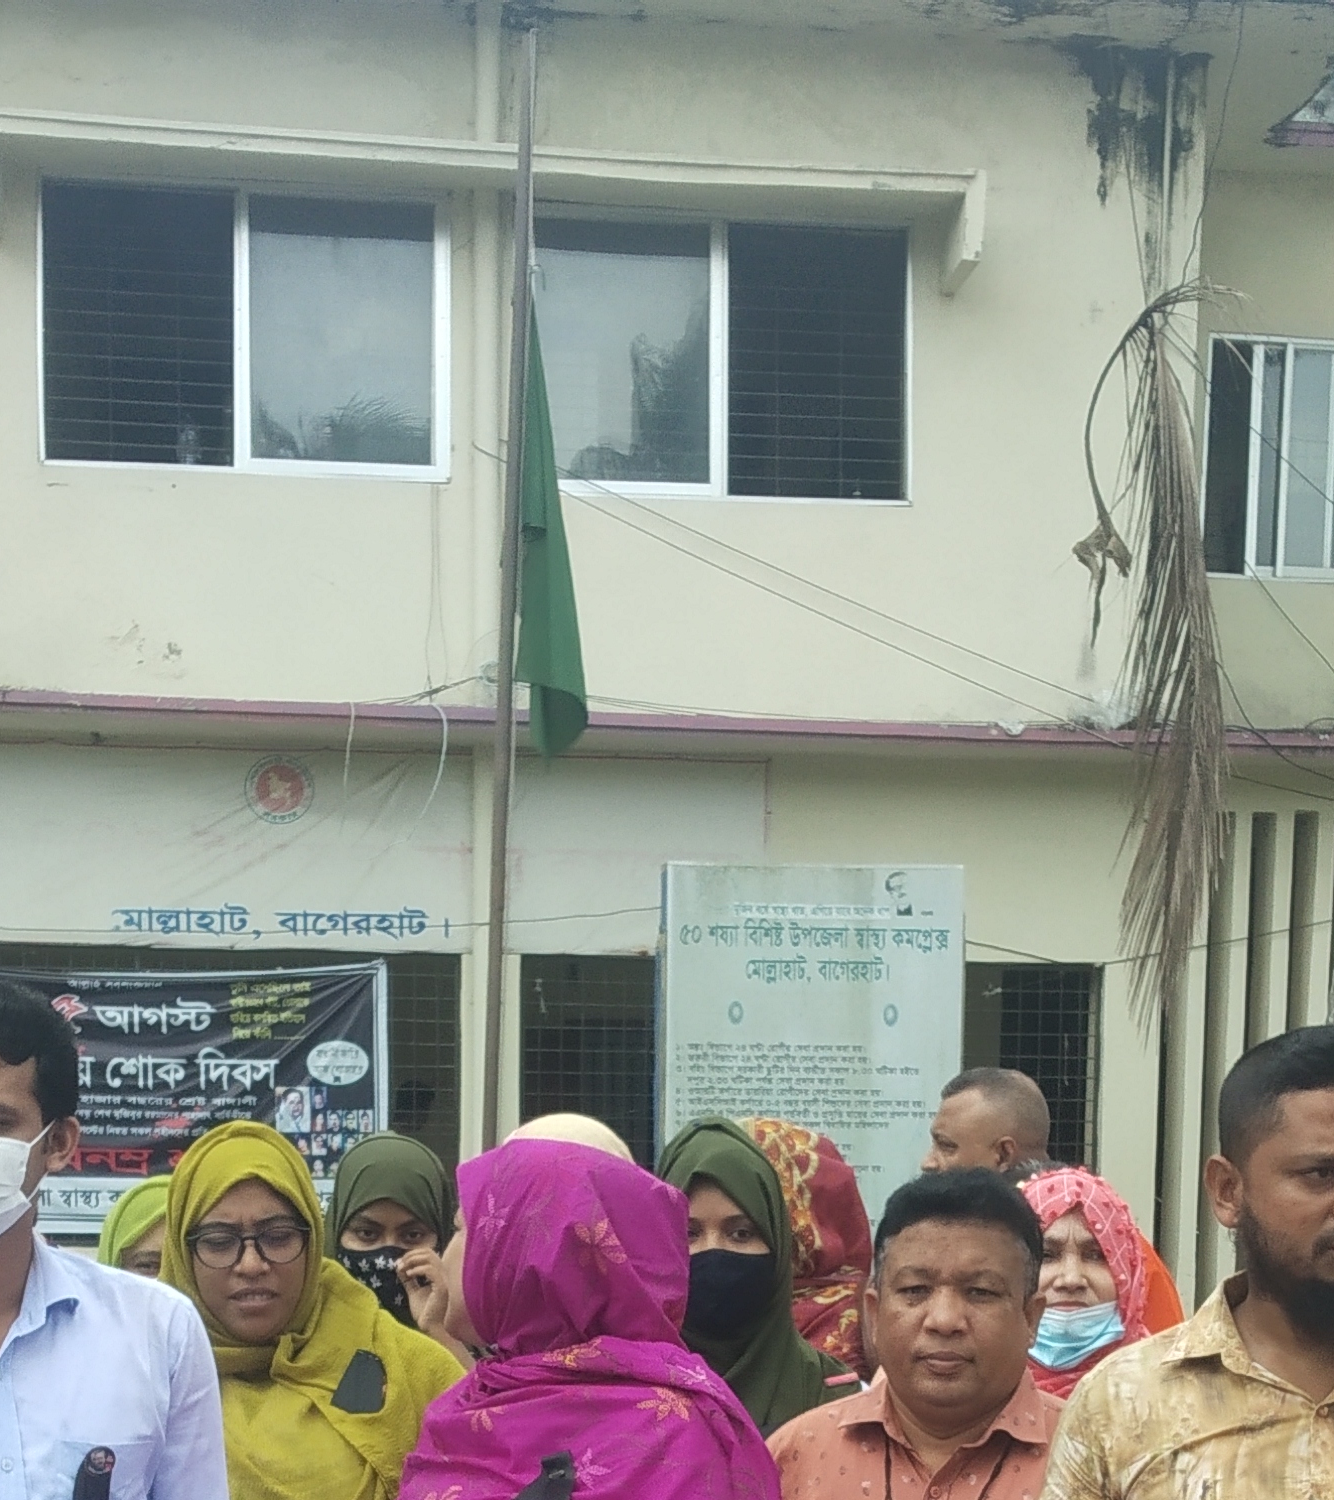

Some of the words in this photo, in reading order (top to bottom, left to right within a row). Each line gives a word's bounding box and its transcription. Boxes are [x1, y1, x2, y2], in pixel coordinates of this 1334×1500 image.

[679, 925, 702, 945] ৫০
[788, 922, 850, 948] উপজেলা
[92, 997, 217, 1036] আগস্ট
[105, 1054, 188, 1090] শোক
[197, 1047, 280, 1090] দিবস
